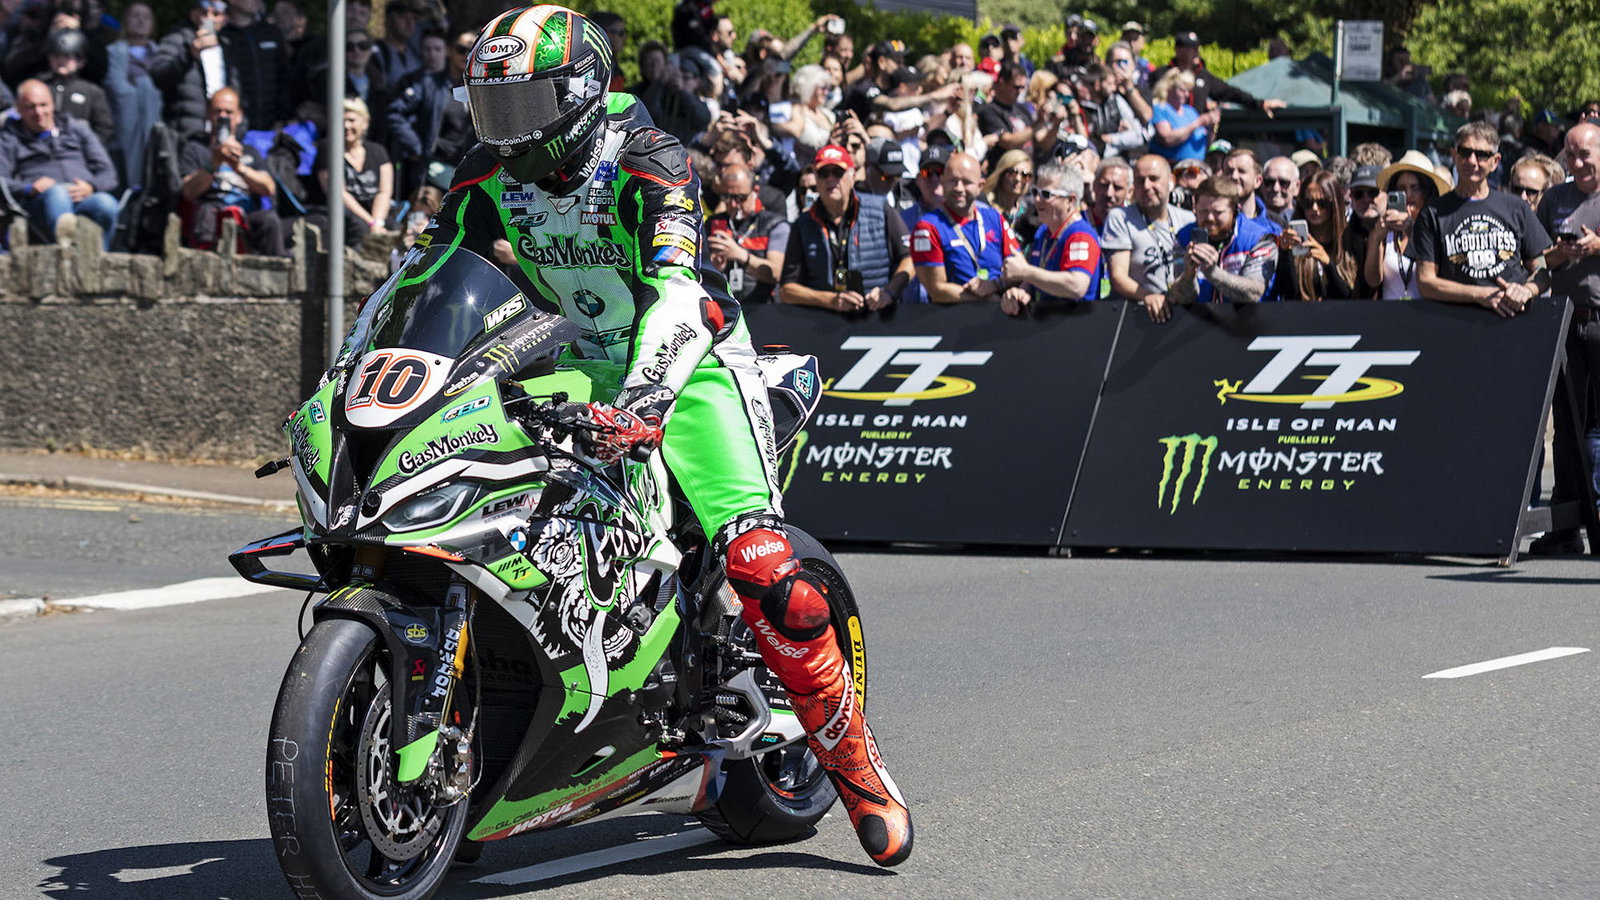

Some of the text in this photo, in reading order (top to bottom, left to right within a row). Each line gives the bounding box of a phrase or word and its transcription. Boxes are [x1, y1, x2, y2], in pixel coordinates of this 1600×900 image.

[480, 44, 518, 55] SUOMY
[579, 138, 604, 178] Weise
[501, 192, 534, 201] LEW
[663, 191, 694, 211] sbs
[582, 213, 616, 225] MOTUL
[516, 233, 632, 269] GasMonkey
[507, 321, 554, 350] MONSTER
[521, 331, 552, 352] ENERGY
[642, 322, 697, 385] GasMonkey
[346, 352, 431, 410] 10
[445, 371, 480, 395] alpha
[832, 336, 994, 407] TT
[1242, 335, 1421, 409] TT
[816, 414, 967, 428] ISLE OF MAN
[1226, 418, 1397, 432] ISLE OF MAN
[861, 431, 912, 440] FUELLED BY
[1277, 436, 1336, 444] FUELLED BY
[398, 423, 499, 475] GasMonkey
[806, 442, 953, 469] MONSTER
[1218, 447, 1385, 475] MONSTER
[821, 471, 926, 484] ENERGY
[1237, 478, 1355, 491] ENERGY
[482, 493, 527, 516] LEW
[723, 518, 758, 545] 10
[740, 540, 785, 563] Weise
[407, 624, 427, 638] sbs
[431, 628, 460, 698] DUNLOP
[851, 639, 867, 699] DUNL
[272, 737, 301, 857] PETER
[495, 805, 549, 830] GLOBAL
[507, 801, 574, 837] MOTUL
